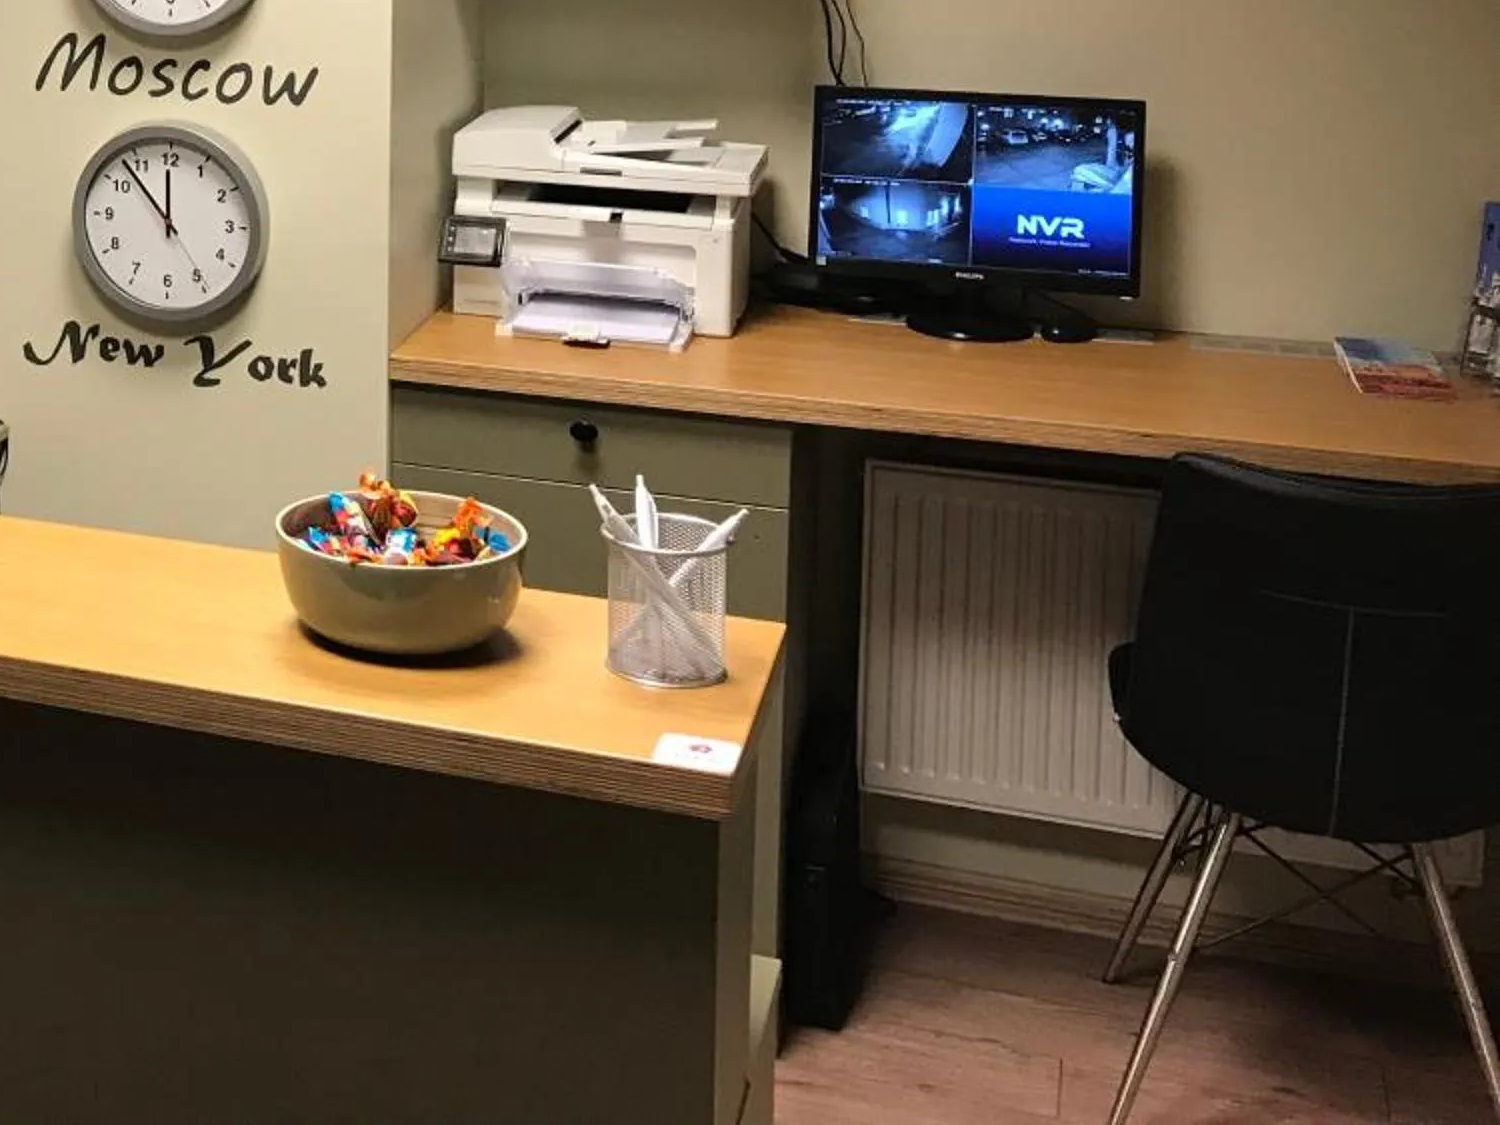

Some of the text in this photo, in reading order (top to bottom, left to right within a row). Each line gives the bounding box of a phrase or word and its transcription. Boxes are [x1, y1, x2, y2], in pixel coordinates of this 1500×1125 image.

[35, 32, 319, 106] Moscow
[134, 158, 148, 172] 11
[162, 152, 179, 167] 12
[197, 165, 203, 178] 1
[112, 179, 130, 193] 10
[218, 189, 226, 202] 2
[105, 207, 114, 220] 9
[225, 220, 234, 233] 3
[1017, 214, 1085, 239] NVR
[111, 237, 119, 250] 8
[216, 248, 224, 261] 4
[132, 262, 141, 275] 7
[164, 274, 172, 287] 6
[23, 321, 327, 388] New York
